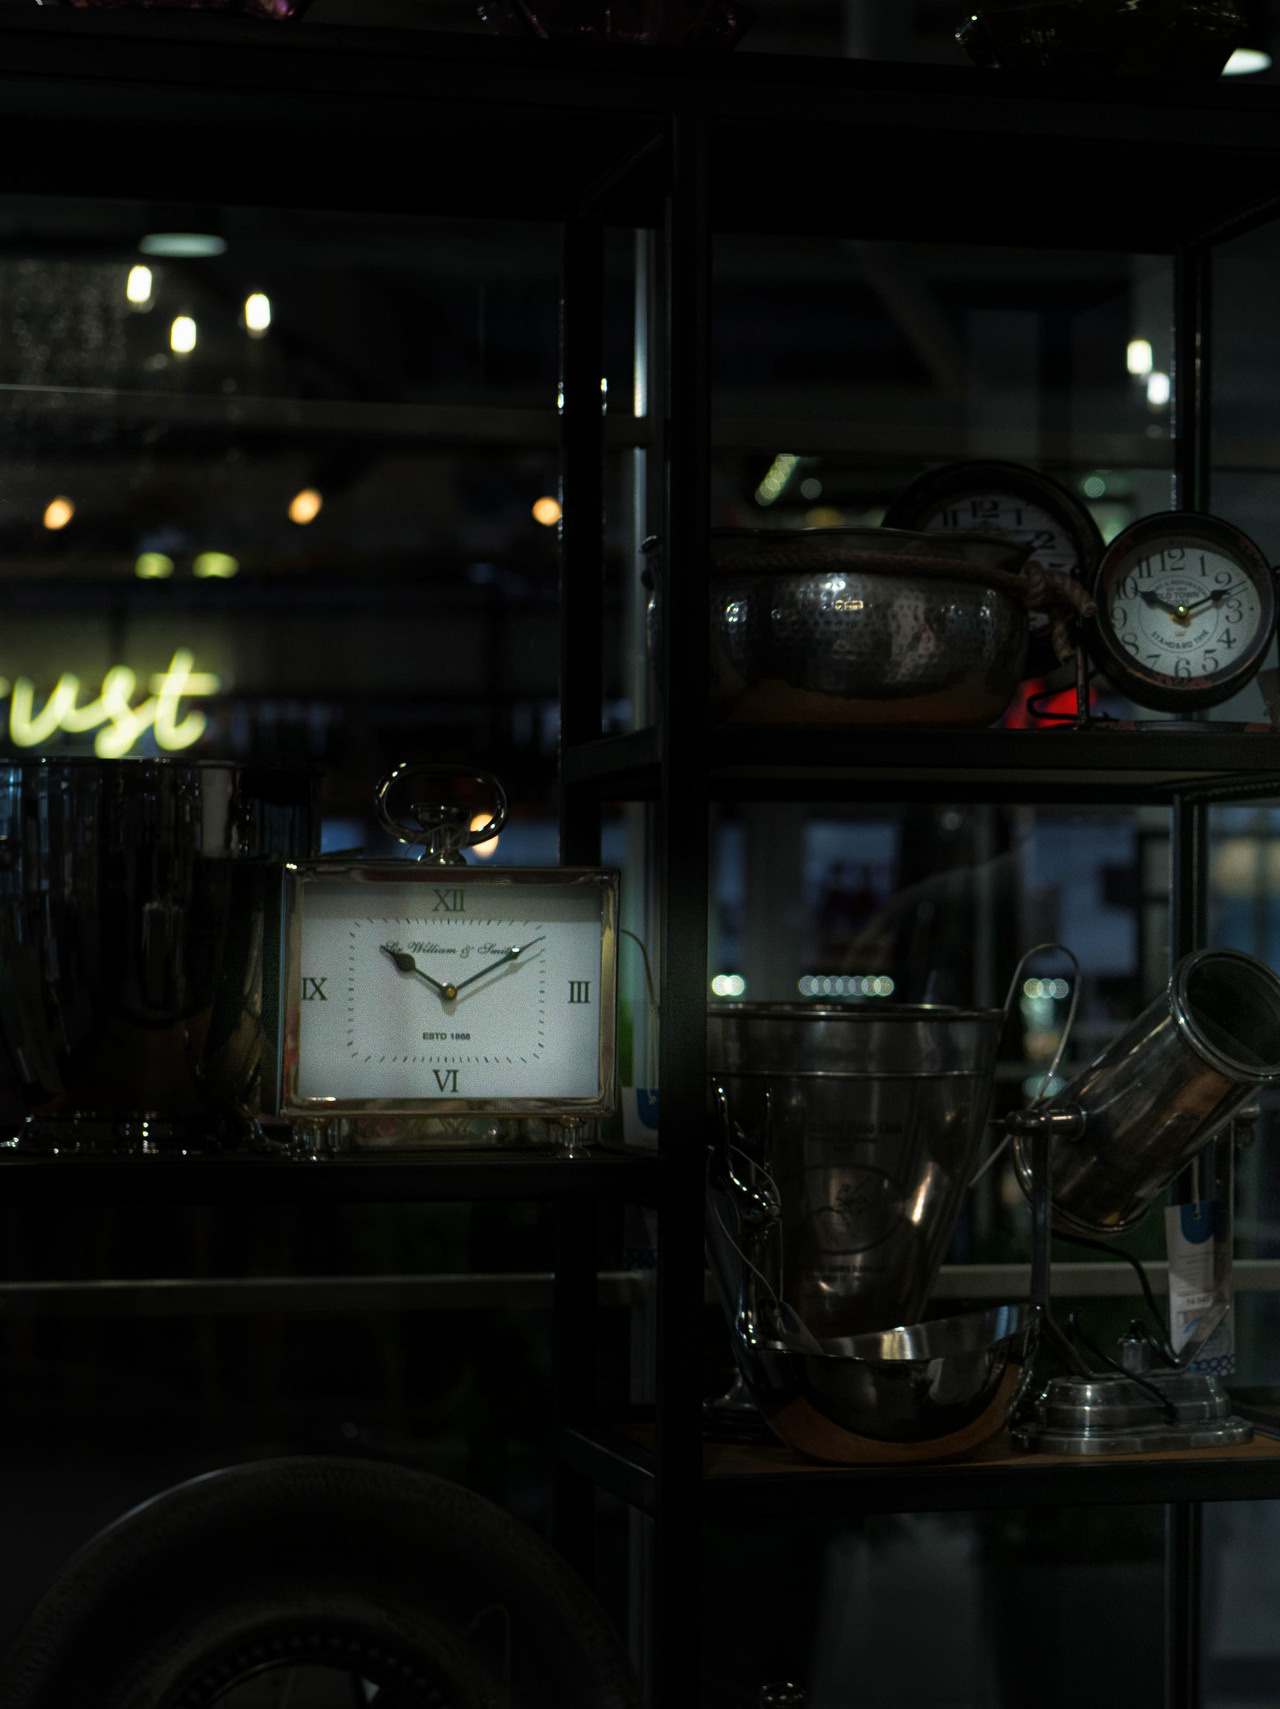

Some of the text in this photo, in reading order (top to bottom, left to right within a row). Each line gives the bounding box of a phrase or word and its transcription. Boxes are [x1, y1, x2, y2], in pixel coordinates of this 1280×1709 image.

[971, 500, 999, 518] 12
[1137, 556, 1154, 579] 11
[1160, 548, 1185, 572] 12
[1199, 554, 1208, 577] 1
[1116, 575, 1138, 600] 10
[1214, 571, 1232, 593] 2
[1112, 606, 1128, 630] 9
[1225, 599, 1243, 624] 3
[1121, 632, 1140, 655] 8
[1151, 631, 1193, 649] STANDARD
[1217, 628, 1237, 649] 4
[1146, 654, 1162, 669] 7
[1174, 657, 1191, 678] 6
[1202, 648, 1219, 673] 5
[0, 646, 222, 760] ust
[432, 889, 466, 913] XII
[407, 940, 456, 954] William
[301, 976, 328, 1001] IX
[567, 980, 591, 1004] III
[422, 1032, 447, 1041] ESTD
[432, 1069, 460, 1093] VI
